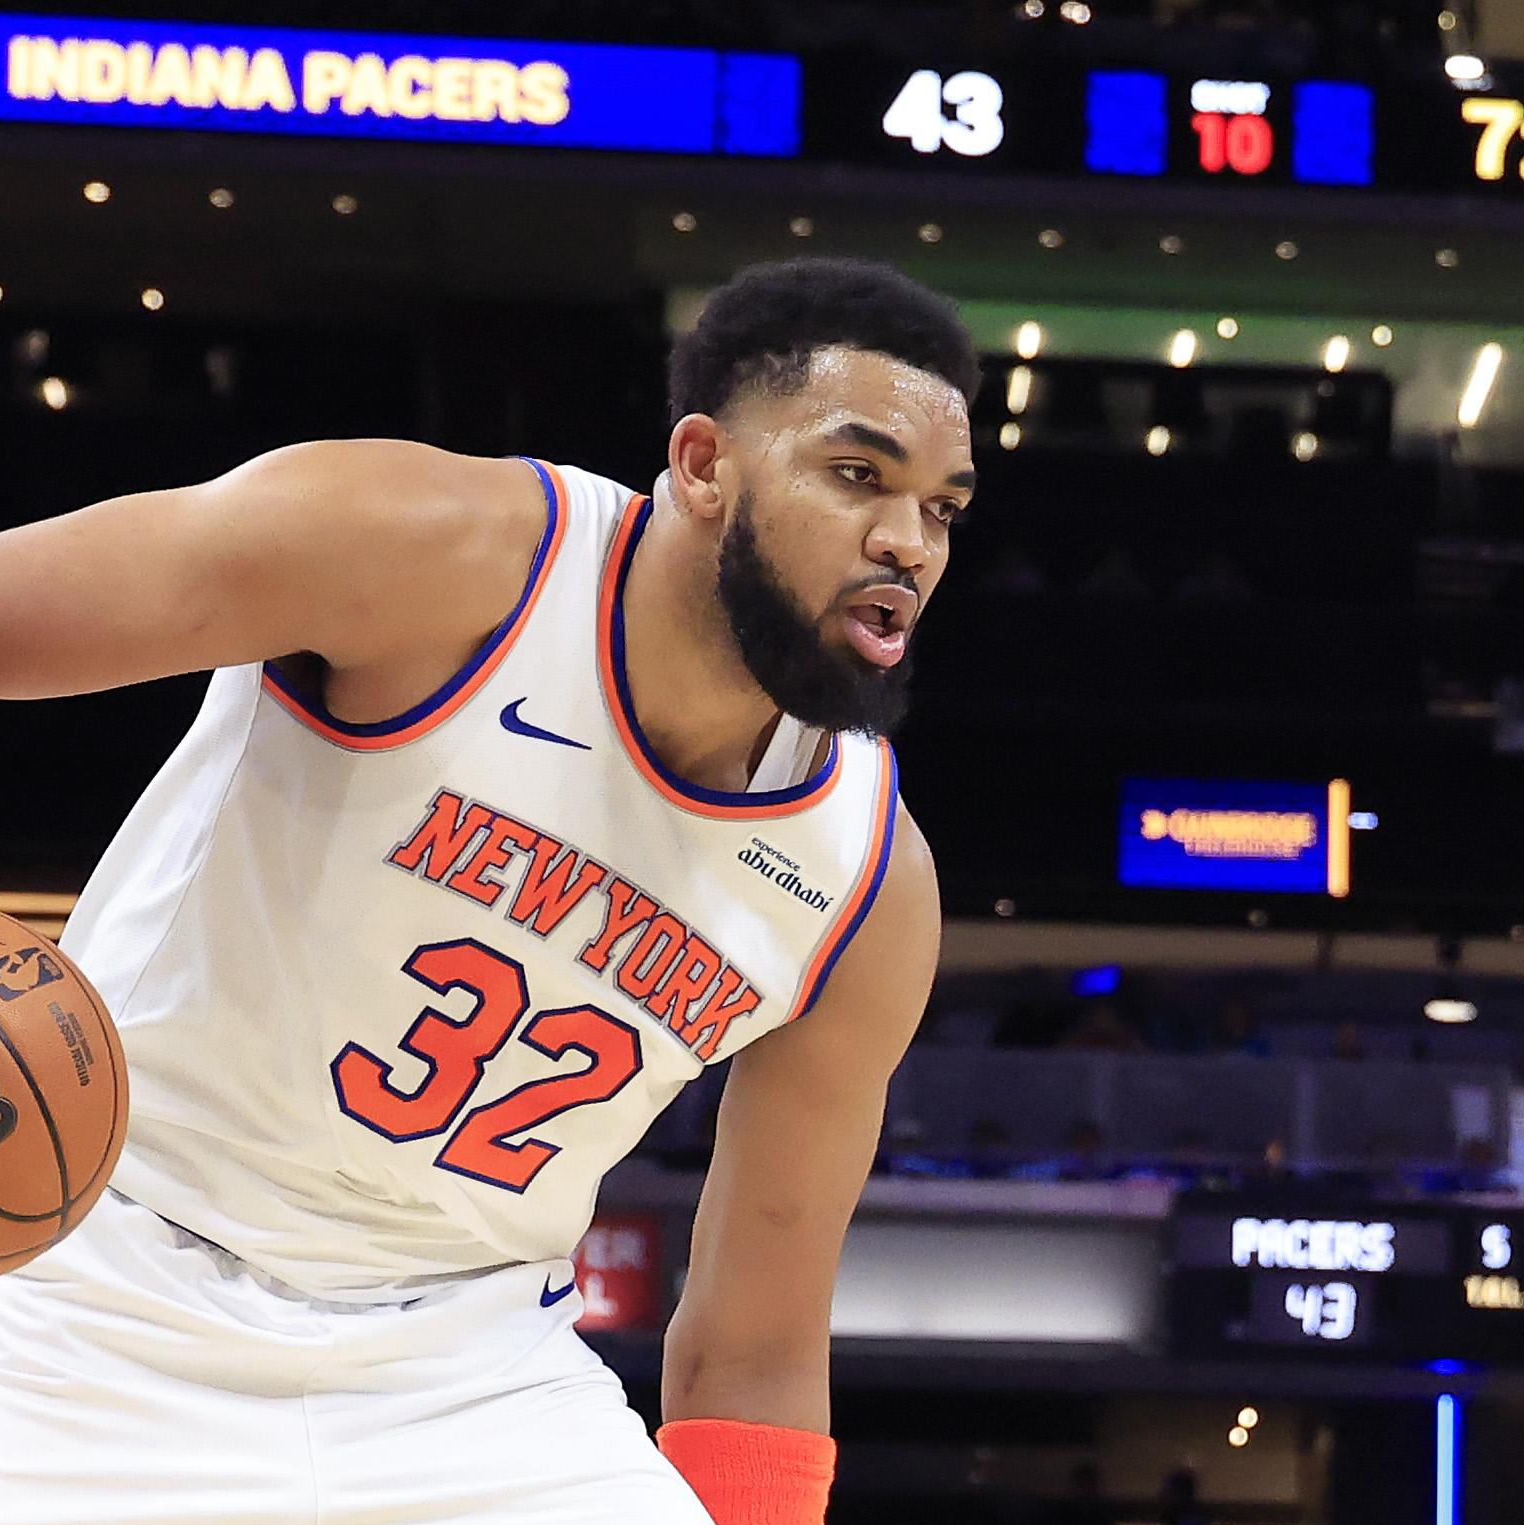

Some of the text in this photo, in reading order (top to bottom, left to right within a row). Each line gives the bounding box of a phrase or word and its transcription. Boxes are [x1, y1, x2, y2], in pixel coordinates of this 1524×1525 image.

[7, 35, 570, 125] INDIANA PACERS
[882, 69, 1004, 156] 43
[1191, 112, 1273, 174] 10
[738, 849, 834, 912] abu dhabi
[751, 837, 801, 871] experience
[383, 786, 766, 1067] NEW YORK
[330, 937, 644, 1195] 32
[1231, 1217, 1396, 1272] PACERS
[1285, 1282, 1357, 1340] 43
